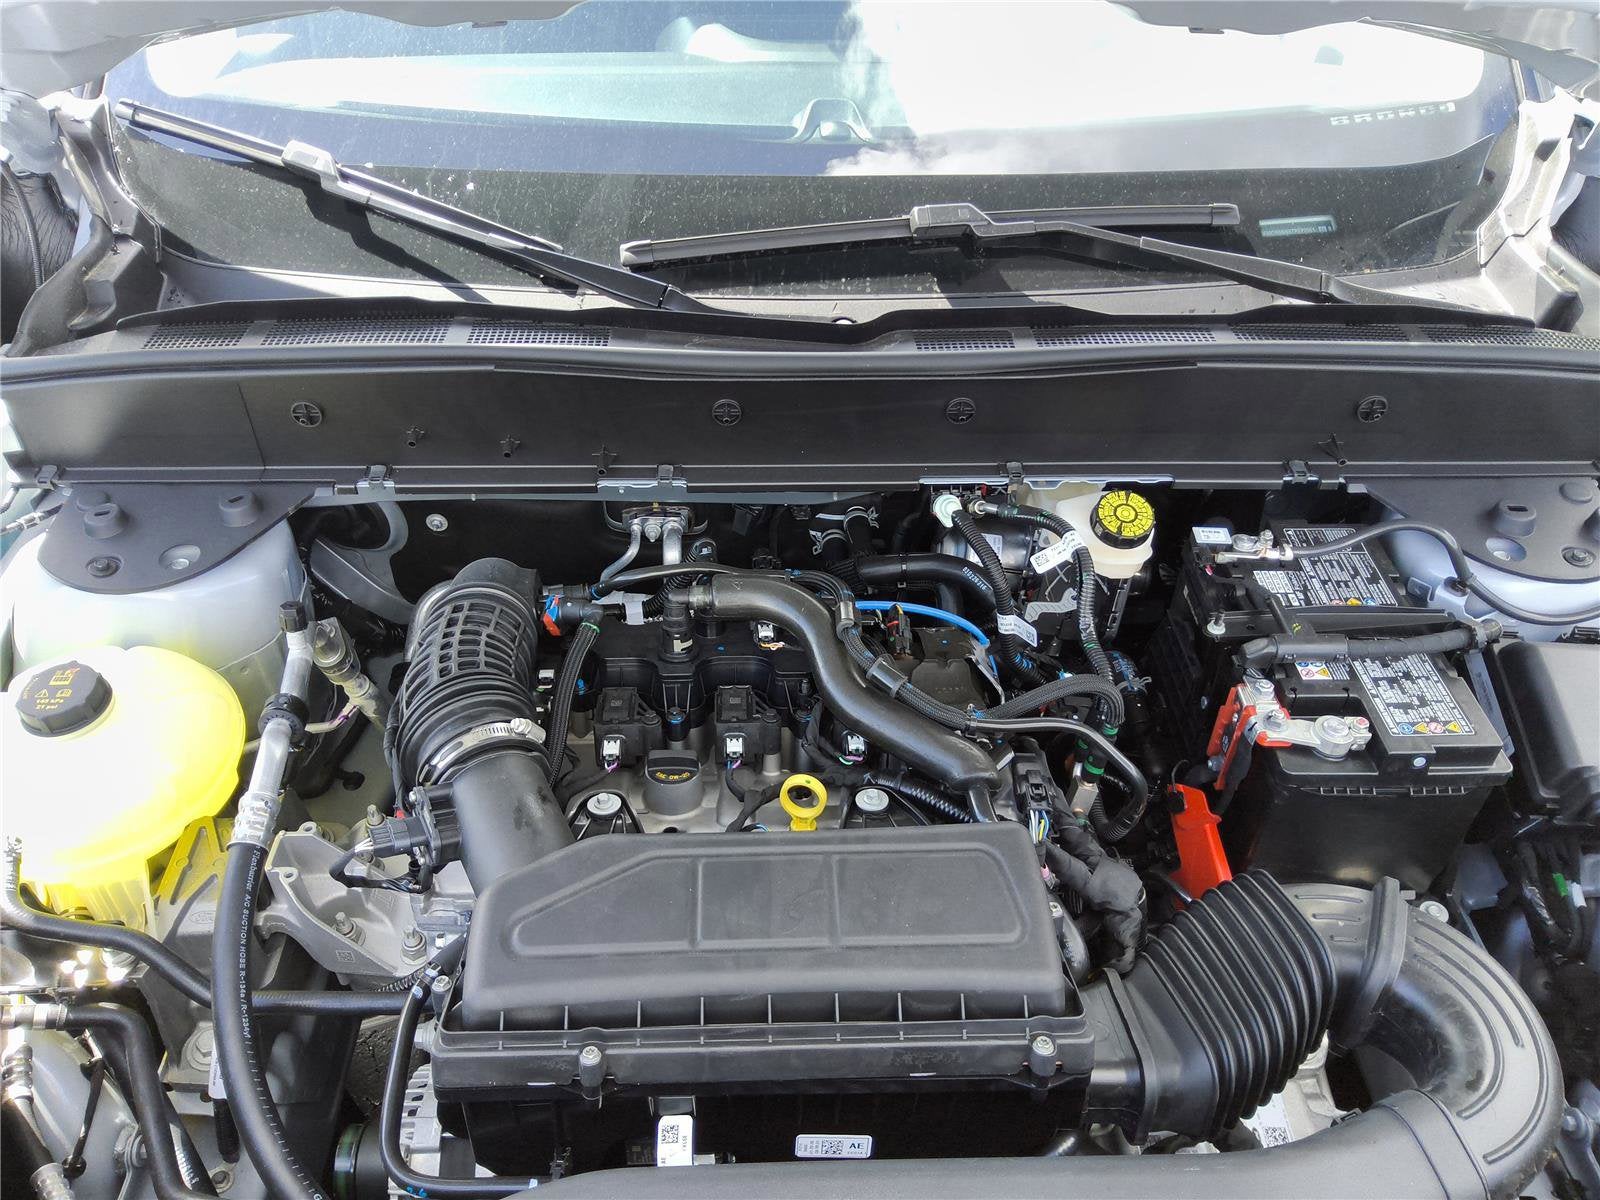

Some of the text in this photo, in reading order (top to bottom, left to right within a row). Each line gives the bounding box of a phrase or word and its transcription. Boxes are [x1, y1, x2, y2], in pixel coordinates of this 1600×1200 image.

[246, 850, 261, 892] Flexbarrier
[243, 894, 252, 908] A/C
[240, 908, 251, 945] SUCTION
[239, 946, 247, 969] HOSE
[239, 970, 247, 998] R-134a
[240, 1004, 252, 1039] R-1234yf
[849, 1142, 865, 1150] AE
